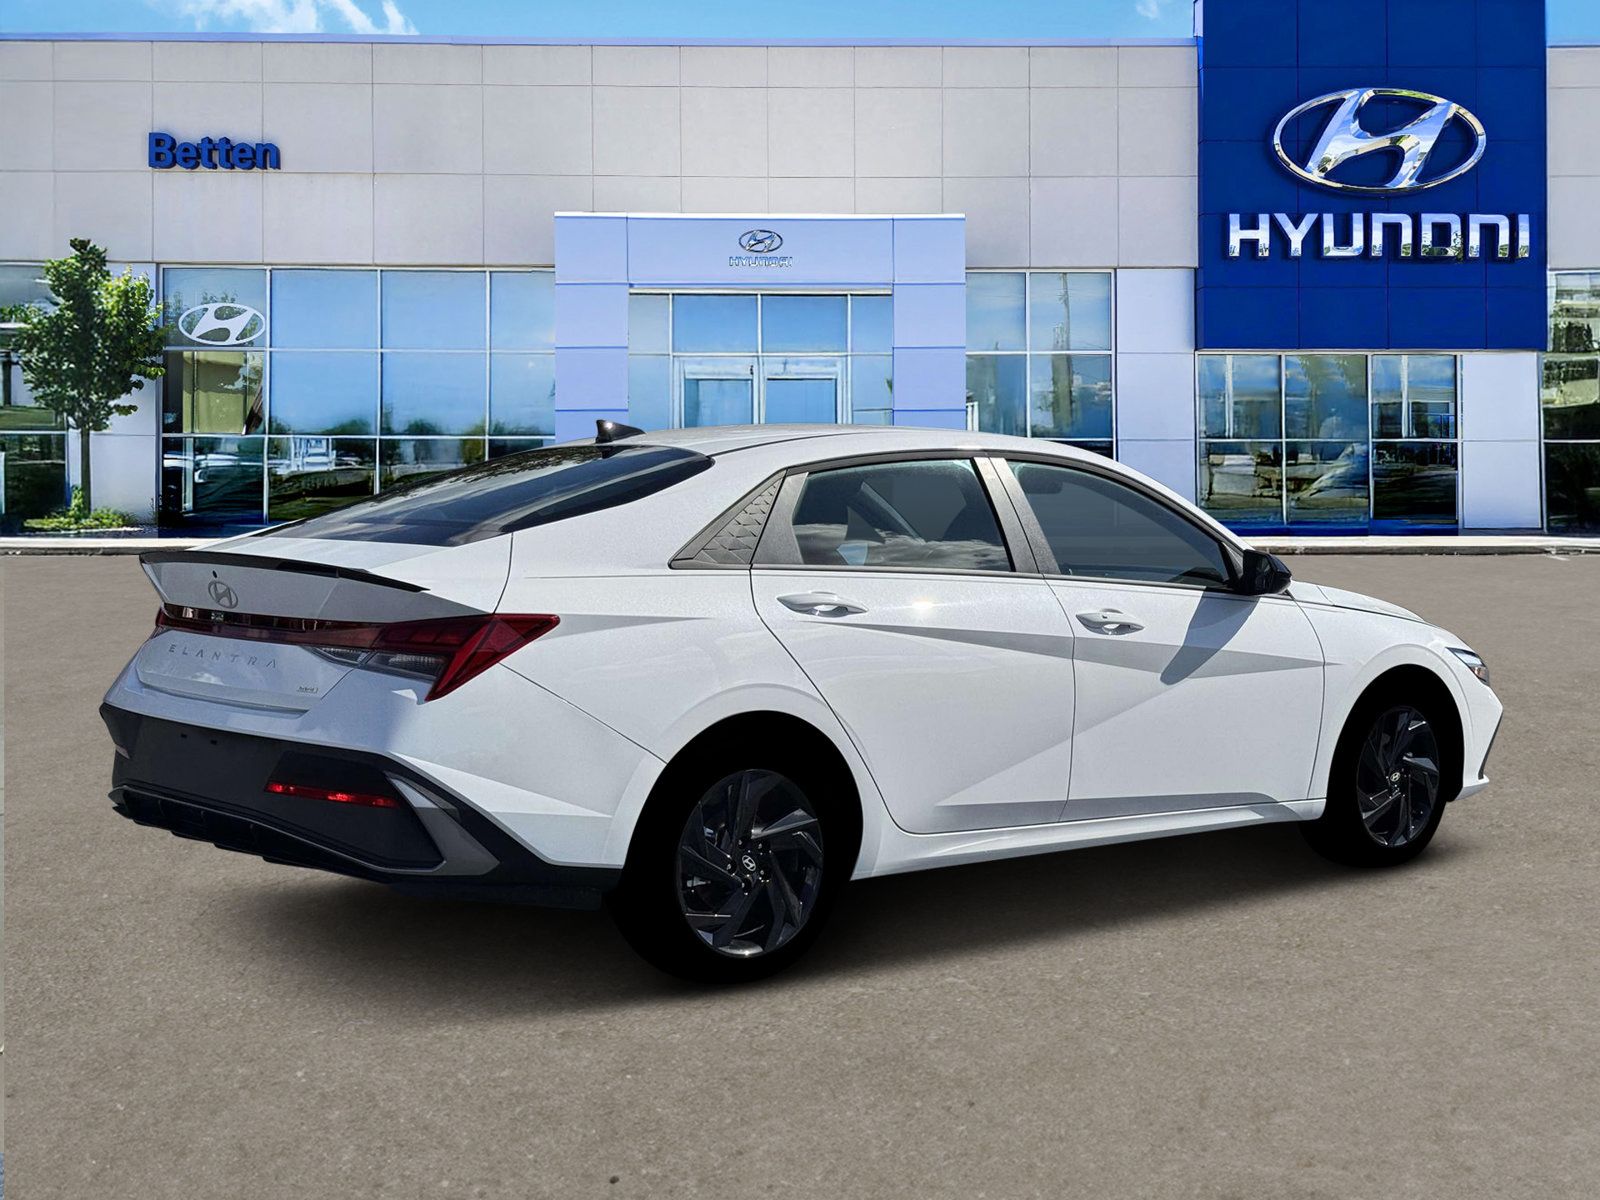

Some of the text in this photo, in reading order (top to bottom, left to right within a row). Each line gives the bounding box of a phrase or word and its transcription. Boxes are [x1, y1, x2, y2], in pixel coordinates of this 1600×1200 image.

[148, 132, 281, 170] Betten
[1228, 212, 1530, 258] HYUNDAI
[728, 256, 793, 267] HYUNDAI
[168, 643, 277, 669] ELANTRA
